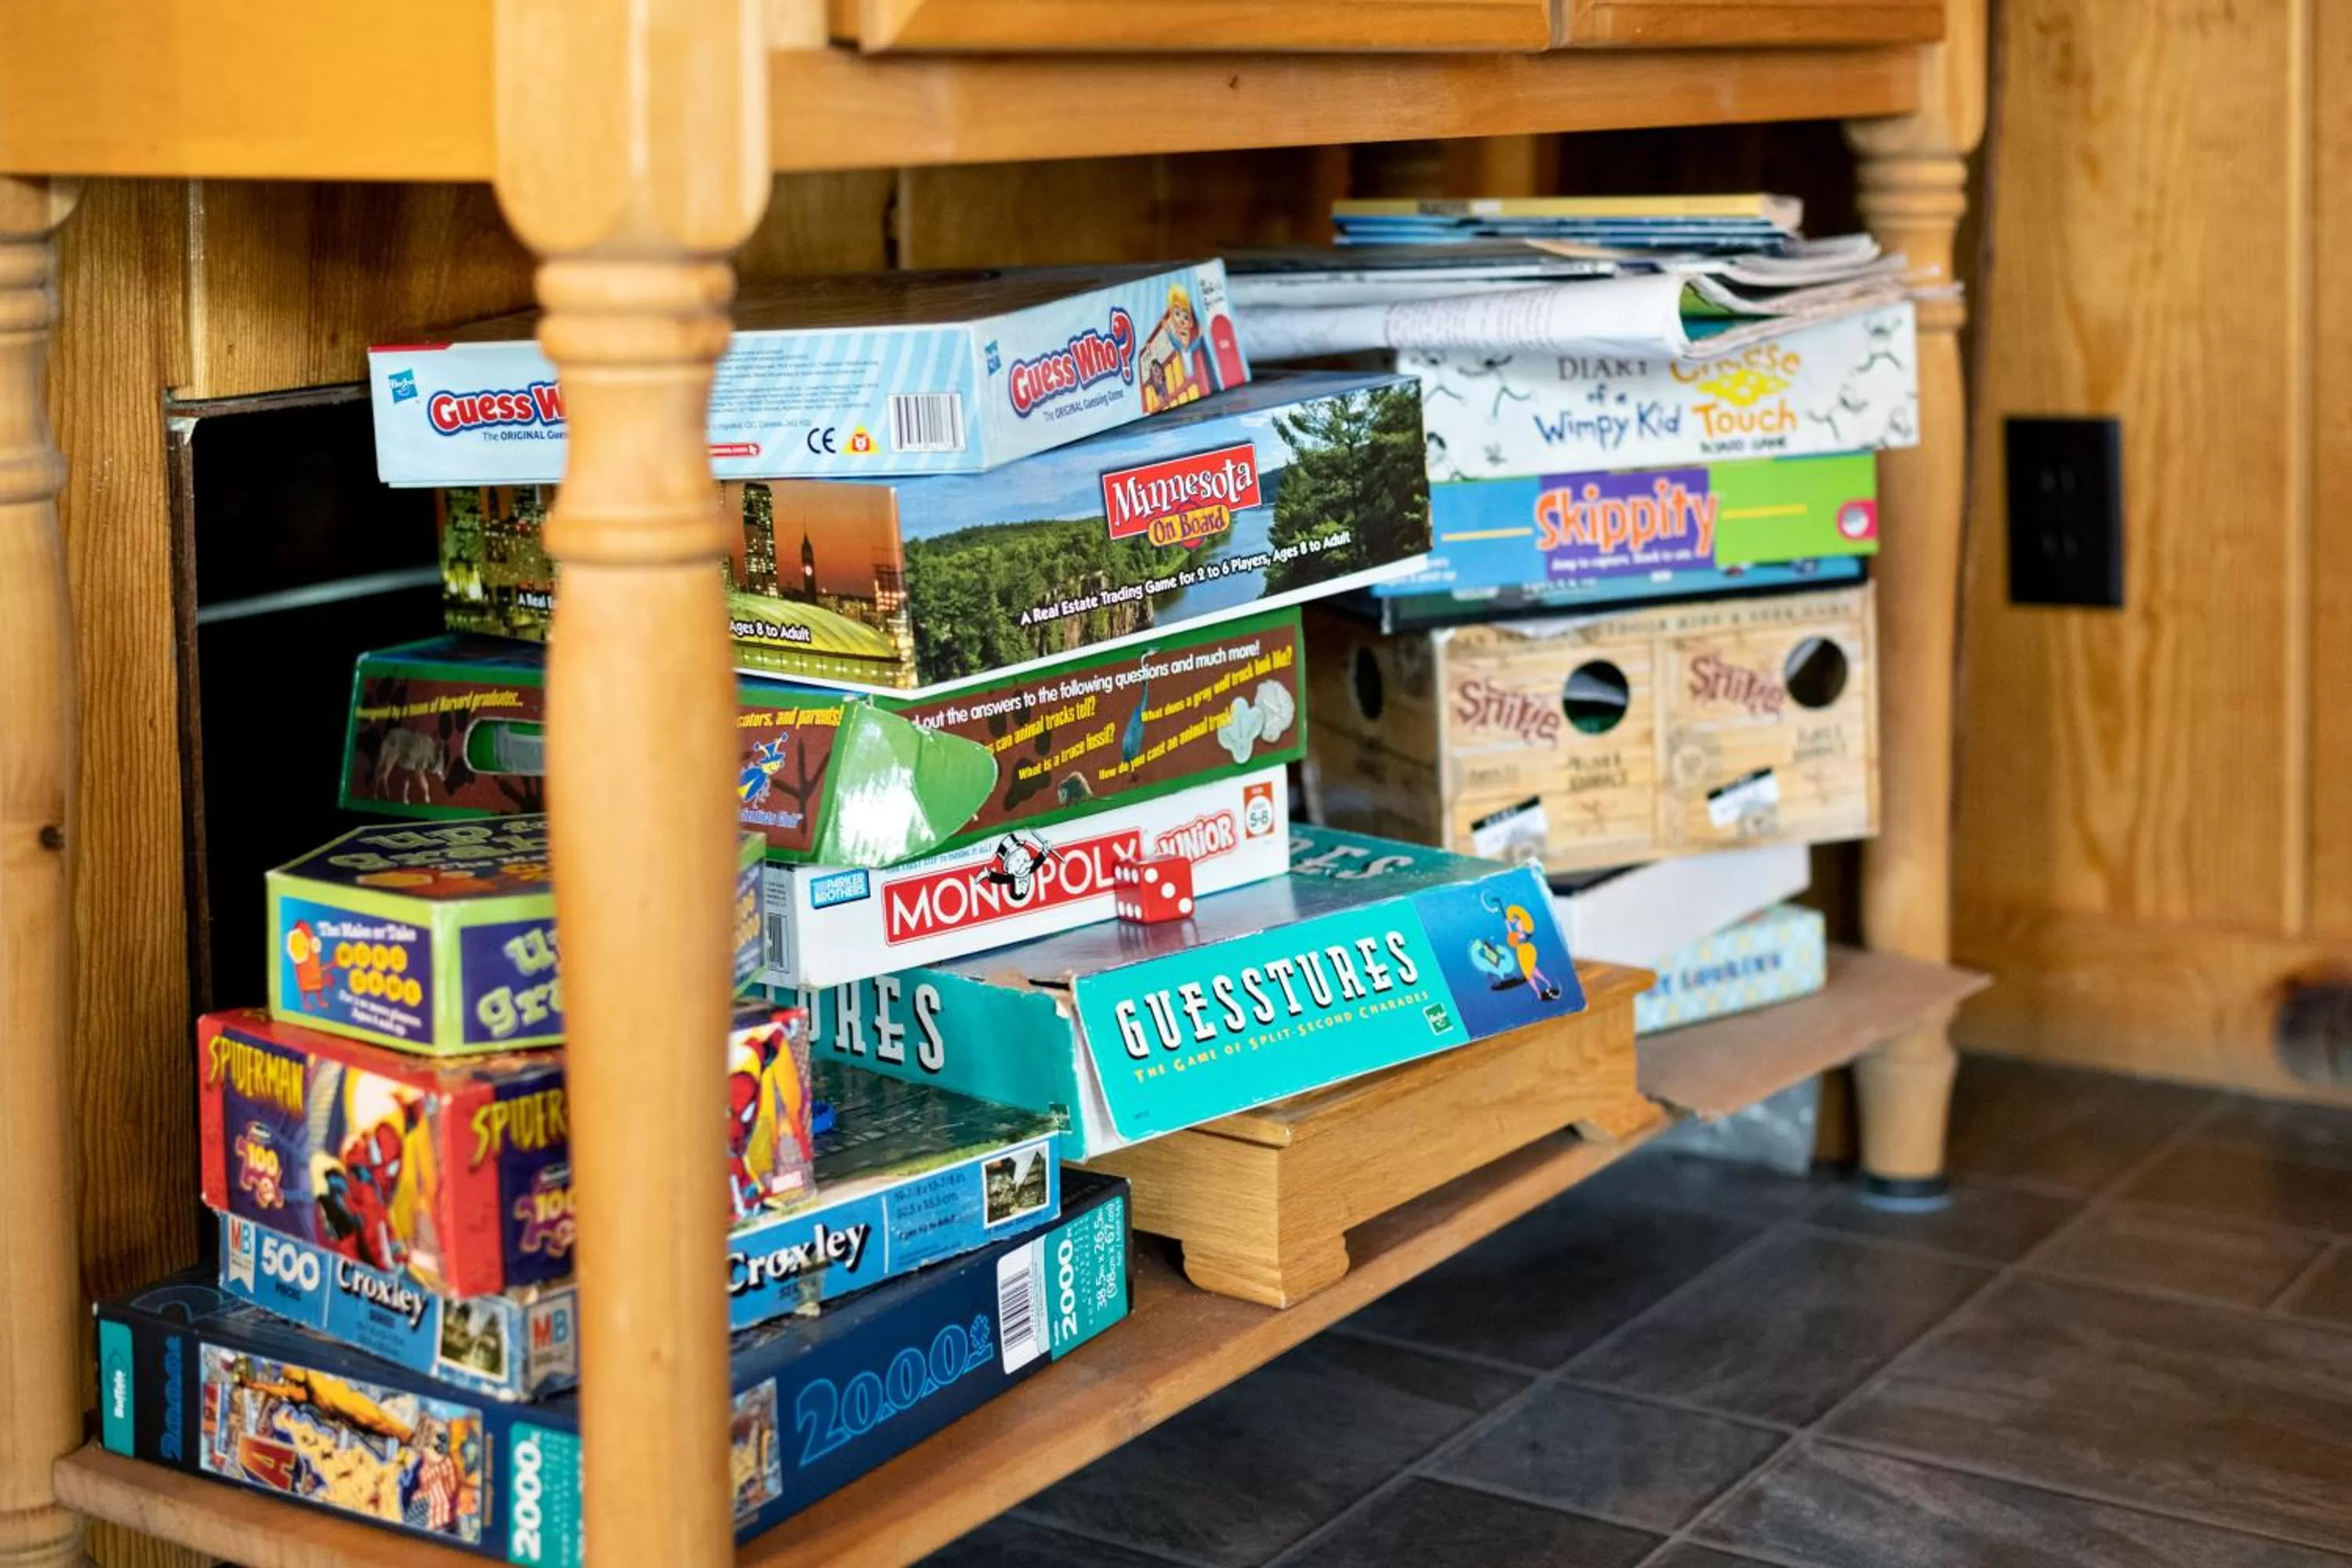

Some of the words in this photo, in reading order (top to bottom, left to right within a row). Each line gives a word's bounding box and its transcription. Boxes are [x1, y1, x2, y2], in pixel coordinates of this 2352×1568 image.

[1010, 354, 1076, 411] Guess
[1071, 310, 1135, 386] Who?
[430, 391, 535, 432] Guess
[483, 431, 499, 441] The
[500, 430, 544, 441] ORIGINAL
[1533, 410, 1630, 451] Wimpy
[1637, 401, 1682, 439] Kid
[1691, 397, 1797, 437] Touch
[1110, 456, 1254, 528] Minnesota
[1535, 477, 1719, 558] Skippity
[1152, 516, 1177, 543] On
[1179, 506, 1225, 539] Board
[1021, 611, 1032, 626] A
[1033, 602, 1059, 622] Real
[1061, 596, 1098, 615] Estate
[1100, 585, 1144, 605] Trading
[1145, 576, 1177, 593] Game
[1178, 572, 1196, 586] for
[1197, 568, 1205, 582] 2
[1207, 565, 1221, 579] to
[1221, 562, 1230, 575] 6
[1231, 554, 1272, 573] Players,
[1272, 547, 1299, 563] Ages
[1300, 542, 1308, 555] 8
[1309, 539, 1321, 552] to
[1323, 531, 1351, 549] Adult
[729, 619, 754, 637] Ages
[756, 622, 764, 636] 8
[766, 624, 779, 637] to
[780, 626, 811, 642] Adult
[923, 711, 945, 729] out
[947, 706, 968, 725] the
[971, 695, 1022, 720] answers
[1023, 692, 1036, 706] to
[1038, 687, 1058, 704] the
[1059, 674, 1113, 699] following
[1115, 663, 1169, 690] questions
[1171, 654, 1194, 674] and
[1196, 648, 1227, 669] much
[1228, 640, 1261, 662] more!
[737, 712, 773, 728] cators,
[776, 706, 797, 725] and
[795, 704, 844, 730] parents!
[996, 734, 1012, 752] can
[1014, 715, 1044, 743] animal
[1045, 706, 1075, 731] tracks
[1076, 695, 1096, 720] tell?
[1018, 762, 1042, 780] What
[1044, 757, 1051, 771] is
[1053, 754, 1060, 766] a
[1061, 741, 1086, 763] trace
[1086, 721, 1116, 751] fossil?
[1098, 768, 1116, 780] How
[1249, 810, 1269, 828] 5-8
[1115, 931, 1419, 1058] GUESSTURES
[1134, 1064, 1167, 1084] THE
[1173, 1050, 1218, 1073] GAME
[1224, 1042, 1243, 1056] OF
[1359, 989, 1429, 1019] CHARADES
[246, 1141, 279, 1177] 100
[261, 1235, 321, 1292] 500
[725, 1222, 870, 1294] Croxley
[336, 1257, 427, 1328] Croxley
[1058, 1239, 1078, 1341] 2000
[532, 1308, 569, 1352] MB
[513, 1440, 543, 1562] 2000
